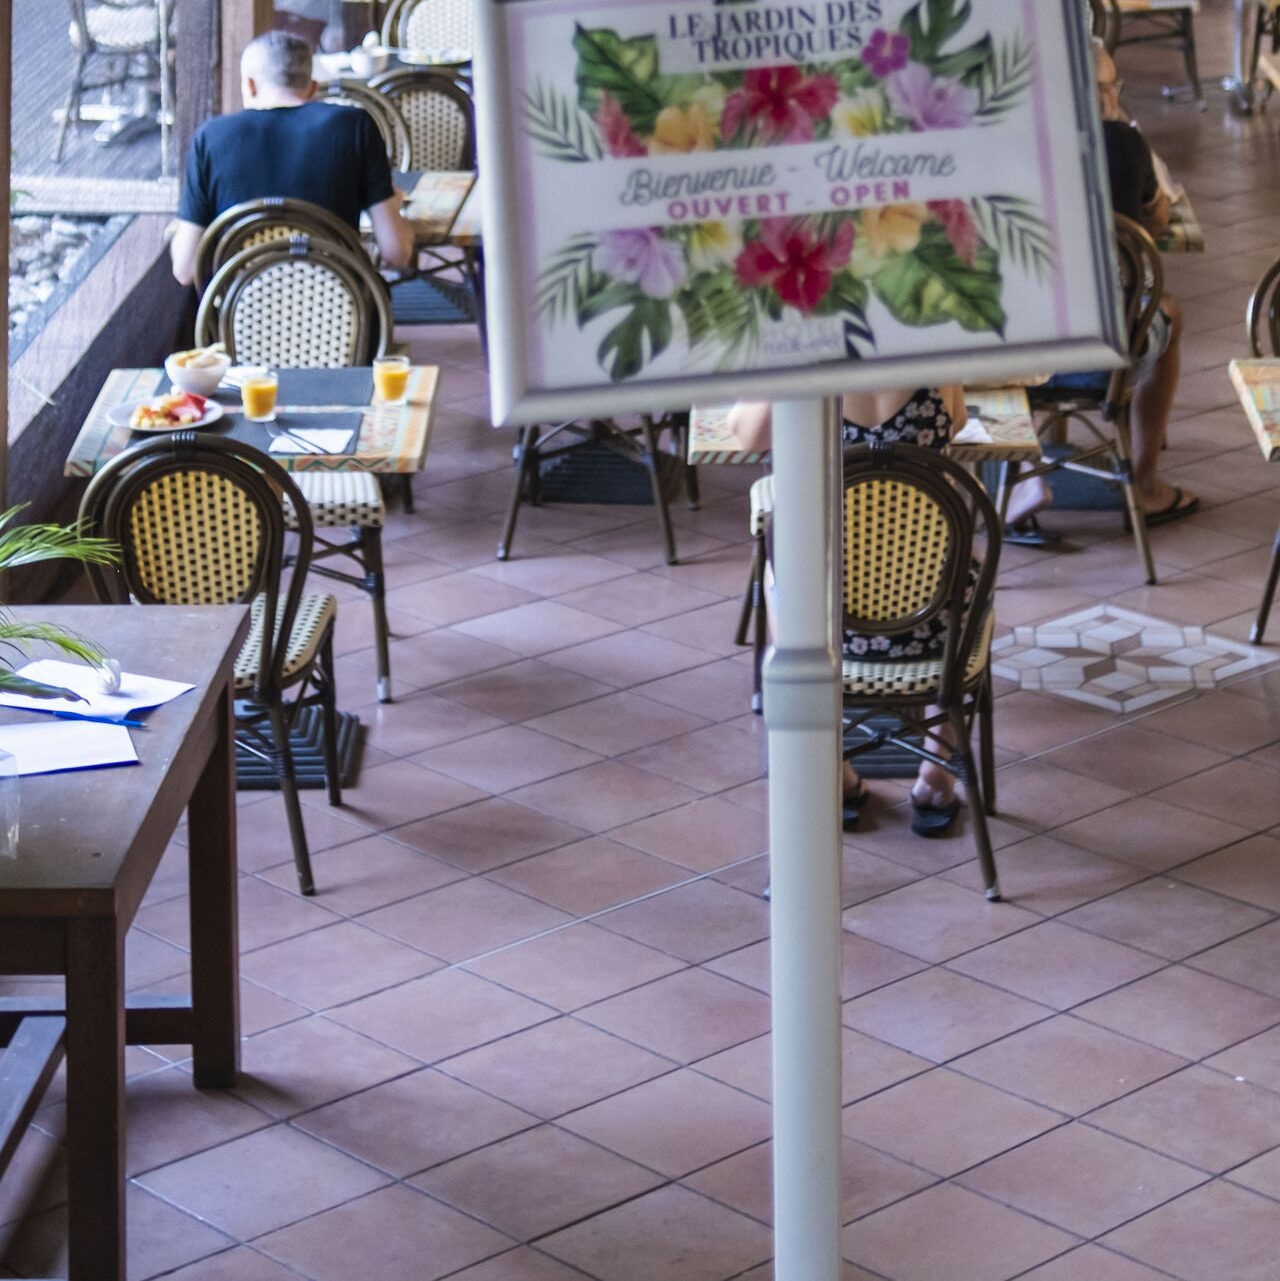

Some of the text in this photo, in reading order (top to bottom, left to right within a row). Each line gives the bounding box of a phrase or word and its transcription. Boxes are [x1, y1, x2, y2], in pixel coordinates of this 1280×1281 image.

[668, 13, 703, 40] LE
[714, 5, 818, 40] JARDIN
[694, 25, 863, 63] TROPIQUES
[619, 163, 777, 207] Bienvenue
[813, 142, 957, 184] Welcome
[667, 190, 790, 220] OUVERT
[829, 179, 911, 207] OPEN
